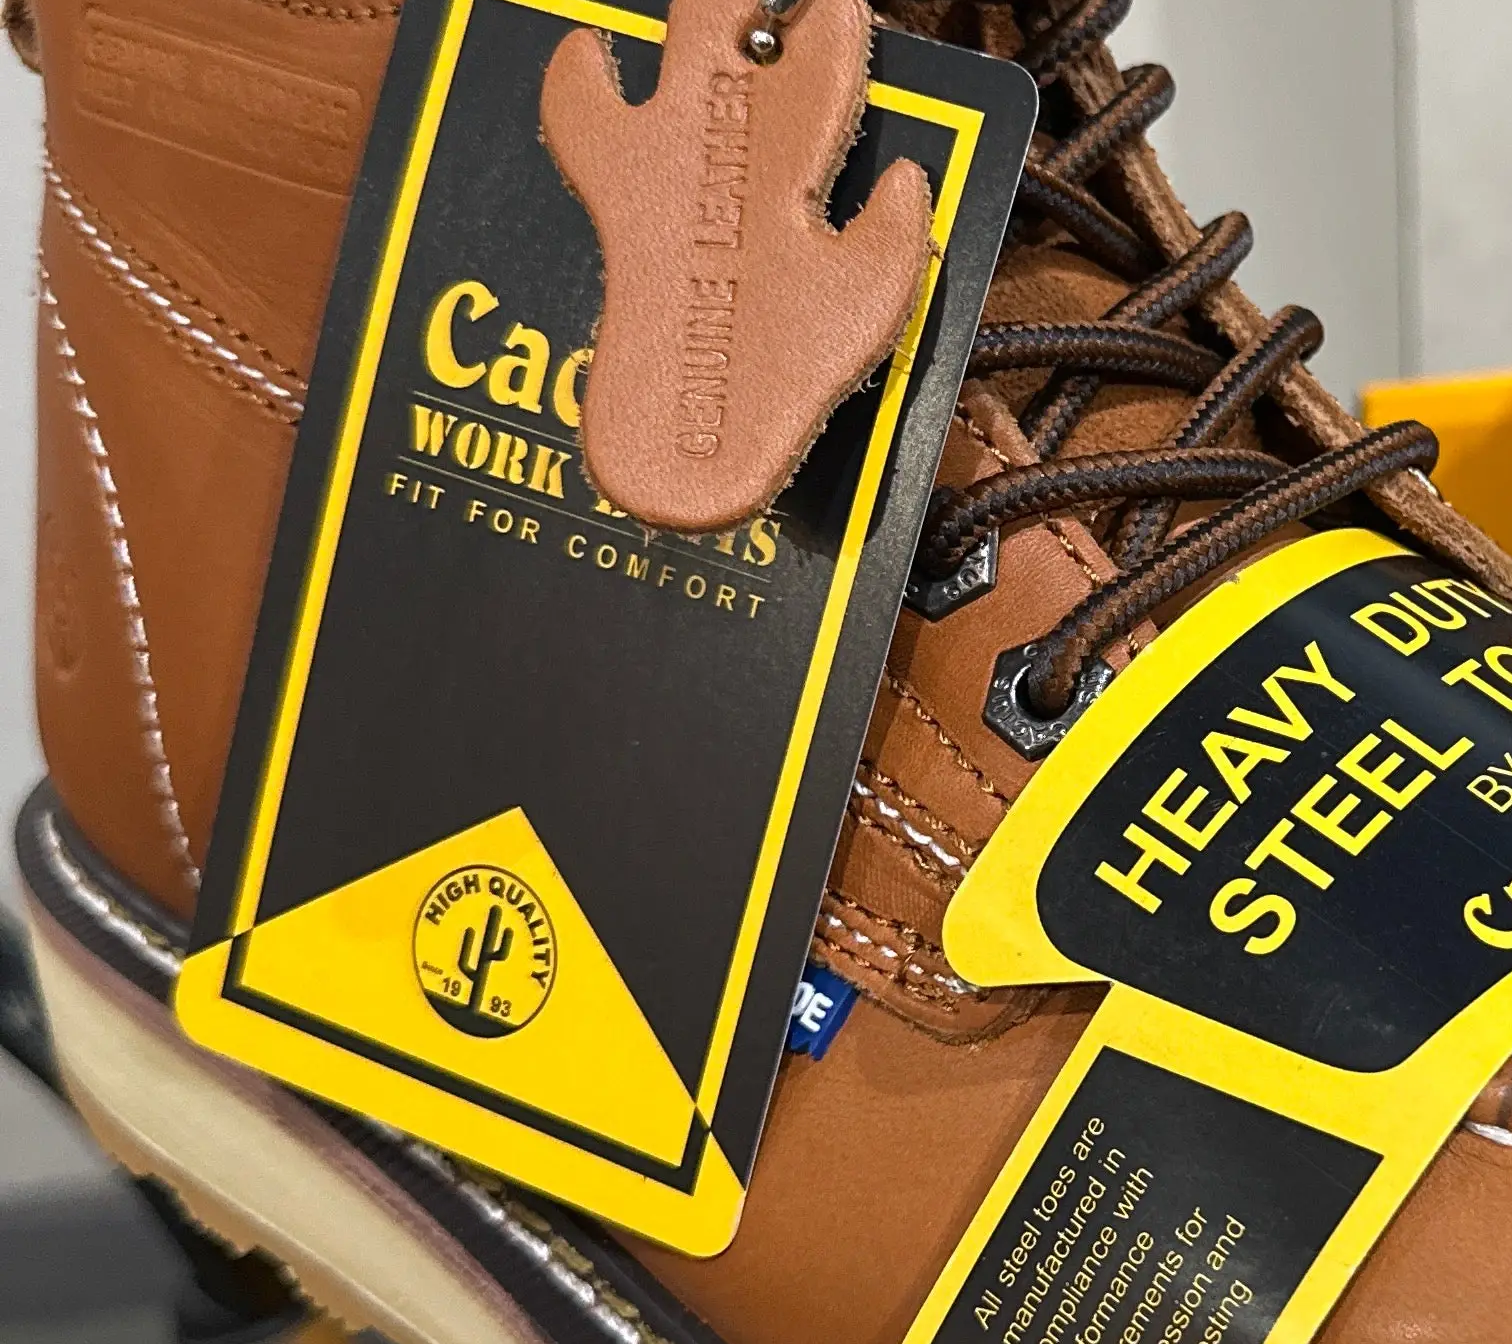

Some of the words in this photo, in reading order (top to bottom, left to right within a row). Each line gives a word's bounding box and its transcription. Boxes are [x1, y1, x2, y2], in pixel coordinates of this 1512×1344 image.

[695, 68, 755, 253] LEATHER
[676, 275, 738, 459] GENUINE
[410, 403, 574, 501] WORK
[388, 471, 444, 512] FIT
[467, 499, 541, 545] FOR
[567, 532, 768, 619] COMFORT
[1094, 640, 1357, 914] HEAVY
[1209, 718, 1476, 955] STEEL
[424, 873, 481, 926] HIGH
[488, 875, 551, 989] QUALITY
[441, 976, 462, 997] 19
[489, 995, 512, 1017] 93
[1102, 1146, 1127, 1172] in
[1112, 1167, 1155, 1220] with
[972, 1289, 1004, 1331] All
[997, 1220, 1043, 1289] steel
[1033, 1164, 1077, 1223] toes
[1072, 1115, 1106, 1162] are
[1175, 1206, 1210, 1245] for
[1206, 1215, 1247, 1274] and
